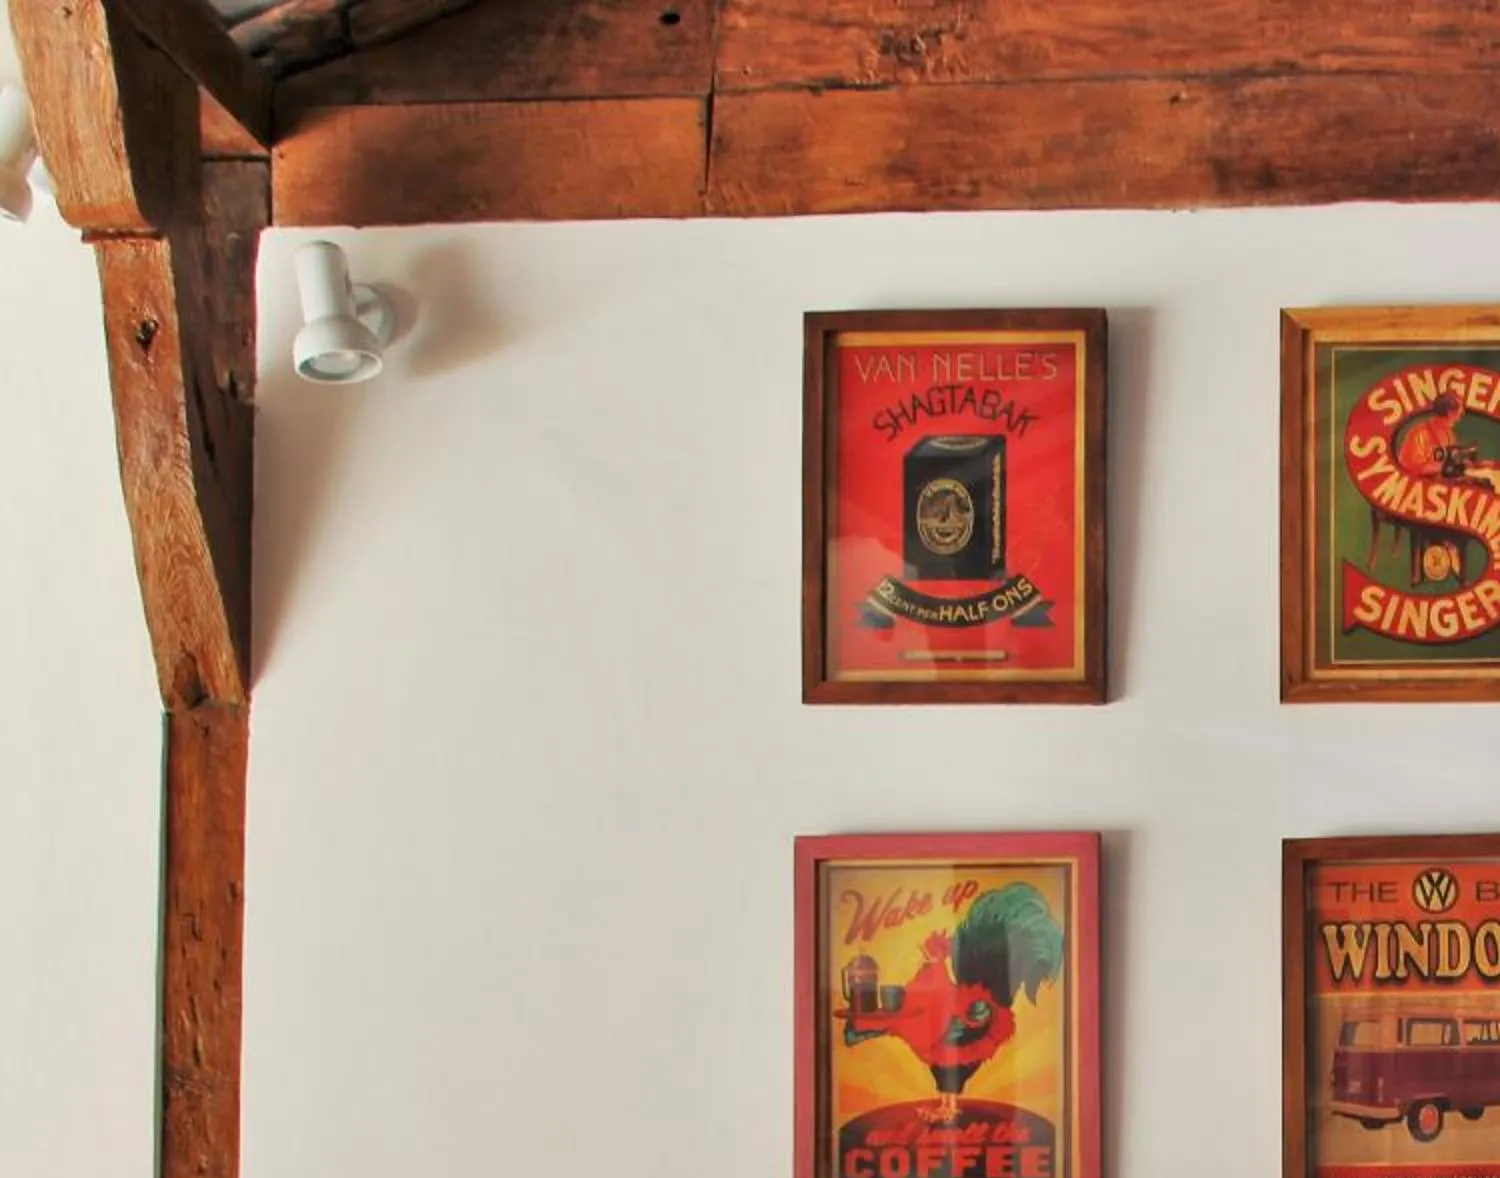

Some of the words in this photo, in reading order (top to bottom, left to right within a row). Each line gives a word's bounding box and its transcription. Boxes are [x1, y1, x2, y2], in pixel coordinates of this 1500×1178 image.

[855, 352, 917, 383] VAN
[932, 351, 1058, 382] NELLE'S
[872, 383, 1040, 442] SHAGTABAK
[939, 600, 990, 623] HALF
[991, 577, 1034, 612] ONS
[840, 885, 932, 946] Wake
[941, 879, 979, 914] up
[1327, 880, 1398, 902] THE
